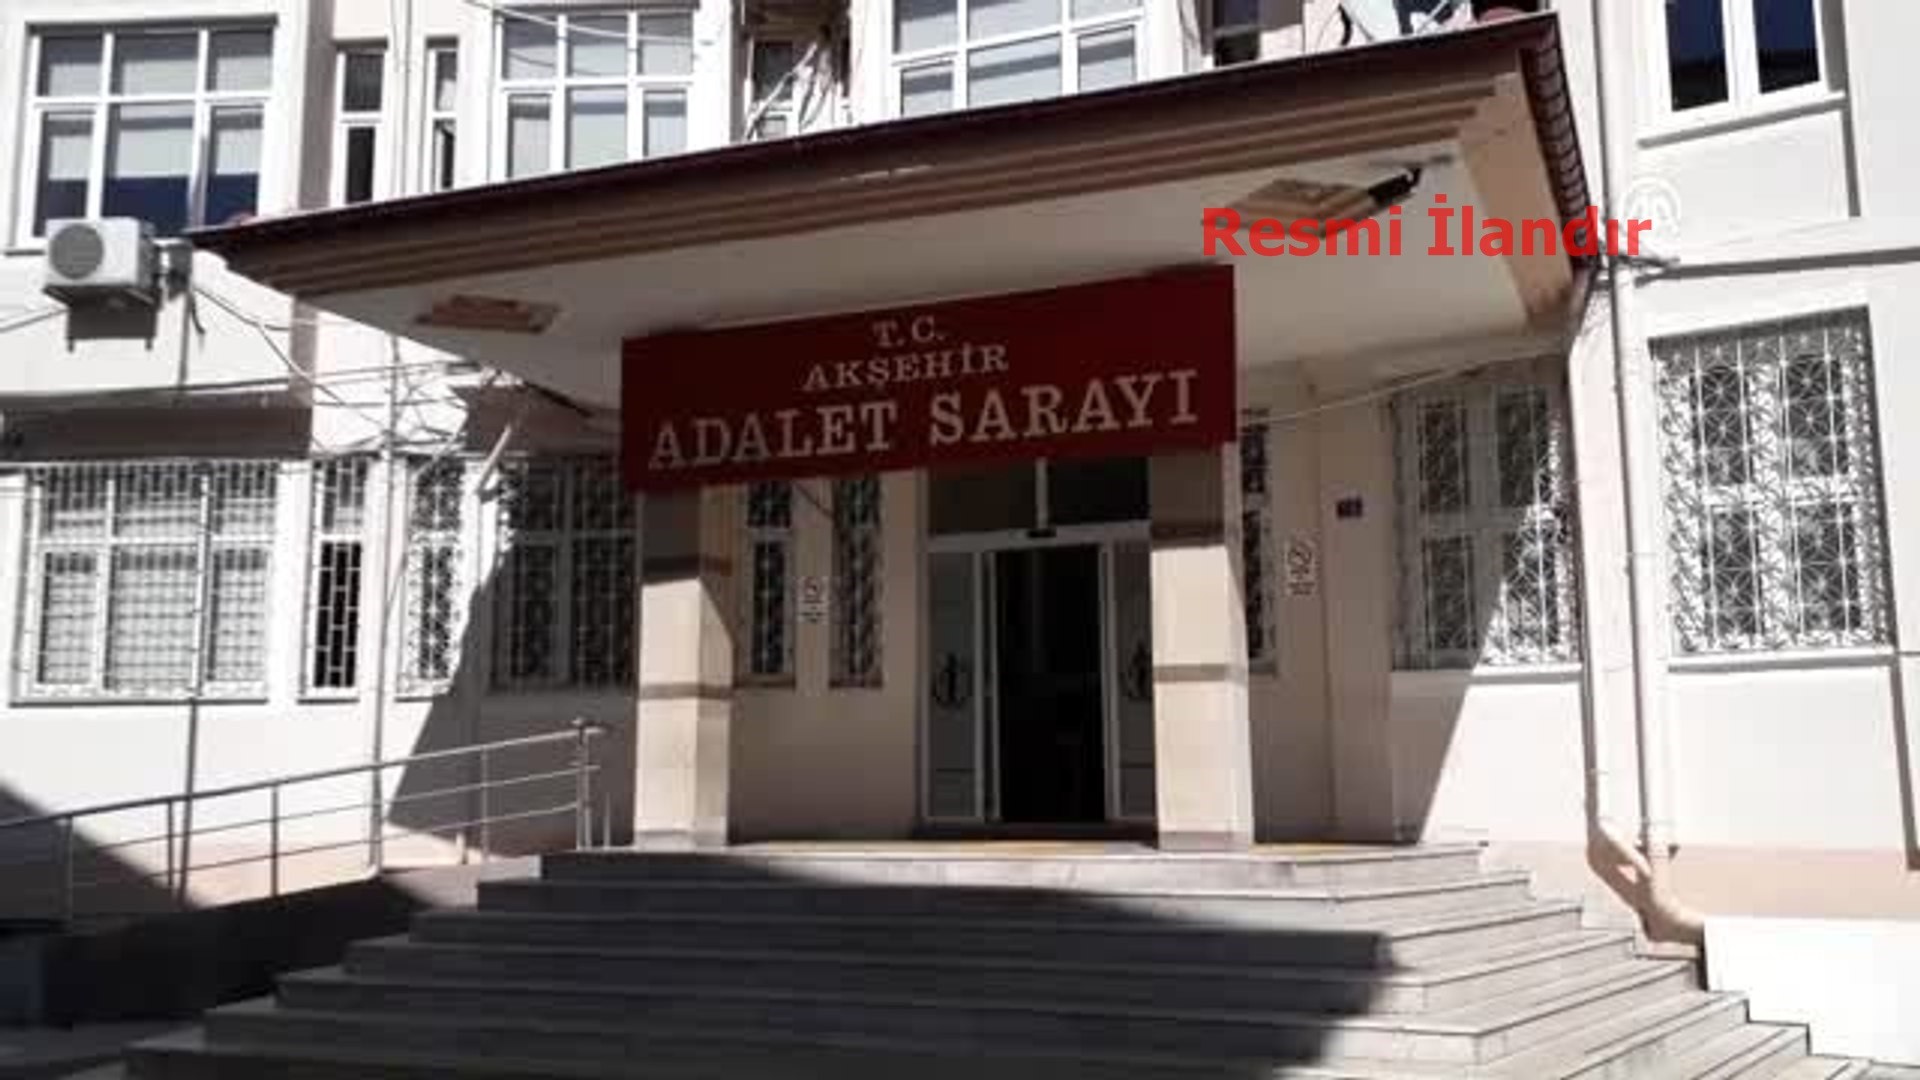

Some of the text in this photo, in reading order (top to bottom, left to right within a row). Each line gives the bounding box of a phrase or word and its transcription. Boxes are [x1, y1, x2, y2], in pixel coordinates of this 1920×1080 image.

[803, 342, 1009, 392] AKŞEHİR
[648, 368, 1199, 470] ADALET SARAYI
